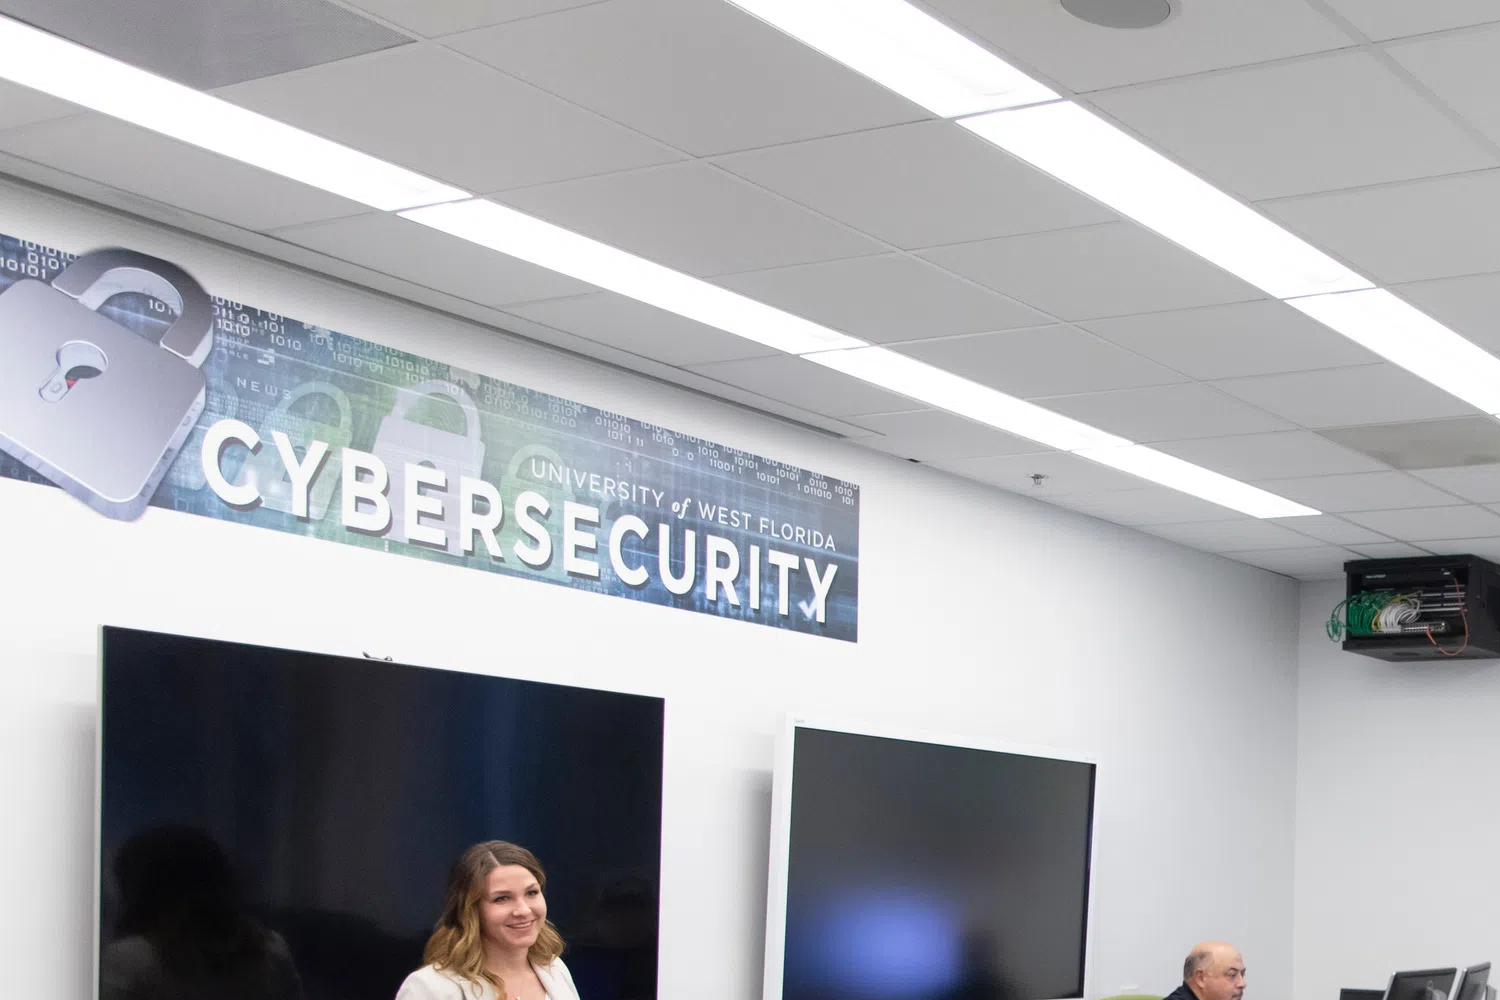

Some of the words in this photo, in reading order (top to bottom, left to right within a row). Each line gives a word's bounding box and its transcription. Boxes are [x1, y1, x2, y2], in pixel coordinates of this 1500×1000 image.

[201, 418, 839, 624] CYBERSECURITY
[531, 458, 665, 508] UNIVERSITY
[672, 497, 692, 520] of
[698, 500, 752, 530] WEST
[760, 517, 837, 552] FLORIDA
